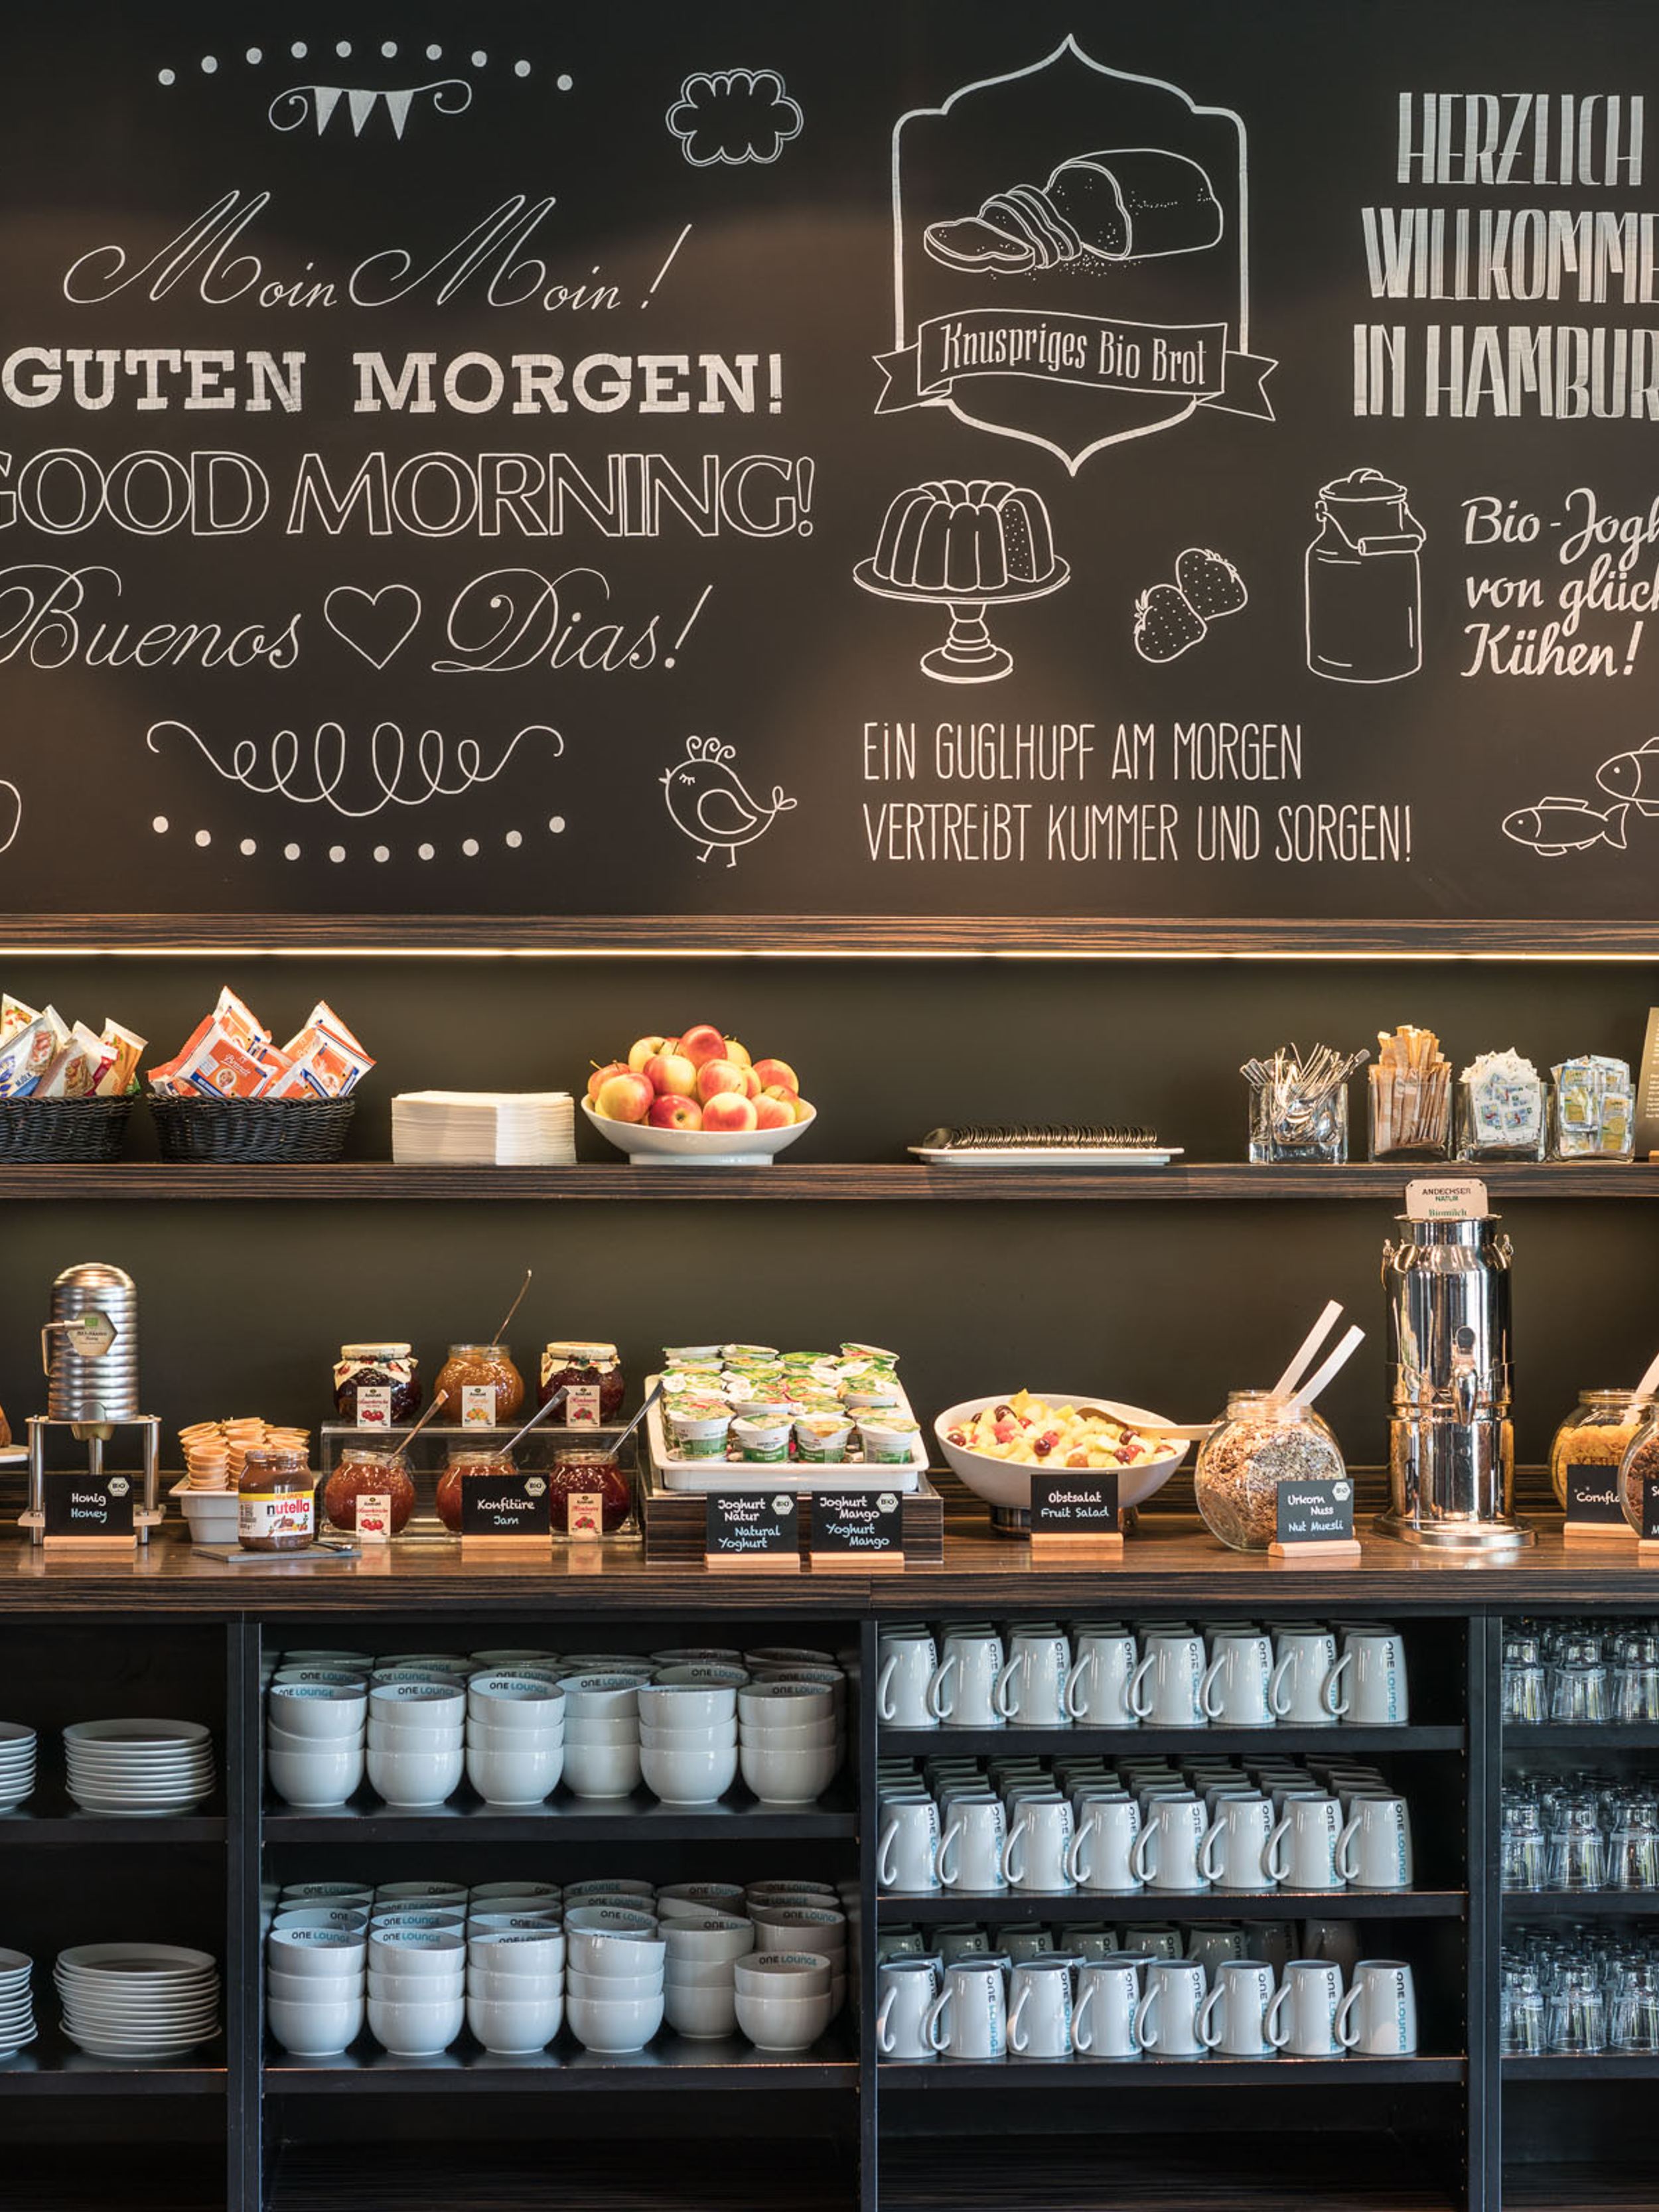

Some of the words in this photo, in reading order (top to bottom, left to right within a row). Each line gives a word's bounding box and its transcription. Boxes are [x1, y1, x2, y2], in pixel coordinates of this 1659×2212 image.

[1398, 93, 1644, 186] HERZLICH
[63, 190, 337, 308] Moin
[940, 322, 1088, 372] Knuspriges
[1098, 330, 1141, 379] Bio
[1151, 337, 1208, 385] Brot
[1354, 324, 1406, 417] IN
[1, 346, 307, 413] GUTEN
[352, 352, 782, 415] MORGEN!
[0, 447, 269, 536] OOD
[286, 451, 815, 537] MORNING!
[1466, 576, 1544, 609] von
[1559, 553, 1659, 637] glüc
[0, 564, 302, 669] Buenos
[431, 567, 713, 673] Dias!
[1461, 621, 1644, 677] Kühen!
[936, 723, 1095, 781] GUGLHUPF
[1112, 723, 1155, 781] AM
[1174, 722, 1301, 781] MORGEN
[1048, 803, 1178, 862] KUMMER
[1197, 805, 1260, 861] UND
[1275, 804, 1411, 863] SORGEN!
[72, 1493, 107, 1507] Honig
[820, 1495, 868, 1511] Joghurt
[1048, 1490, 1102, 1503] Obstsalat
[267, 1499, 310, 1515] nutella
[477, 1497, 536, 1513] Konfitüre
[717, 1497, 766, 1513] Joghurt
[1041, 1507, 1072, 1518] Fruit
[1075, 1505, 1110, 1518] Salad
[1311, 1506, 1334, 1516] Nuss
[70, 1507, 108, 1524] Honey
[493, 1515, 520, 1525] Jam
[724, 1510, 760, 1522] Natur
[839, 1508, 880, 1523] Mango
[734, 1525, 781, 1537] Natural
[825, 1523, 875, 1539] Yoghurt
[1288, 1520, 1307, 1533] Nut
[717, 1537, 768, 1553] Yoghurt
[849, 1536, 891, 1550] Mango
[1395, 1804, 1405, 1831] ONE
[291, 1931, 311, 1940] ONE
[758, 1956, 780, 1965] ONE
[1396, 1970, 1405, 1999] ONE
